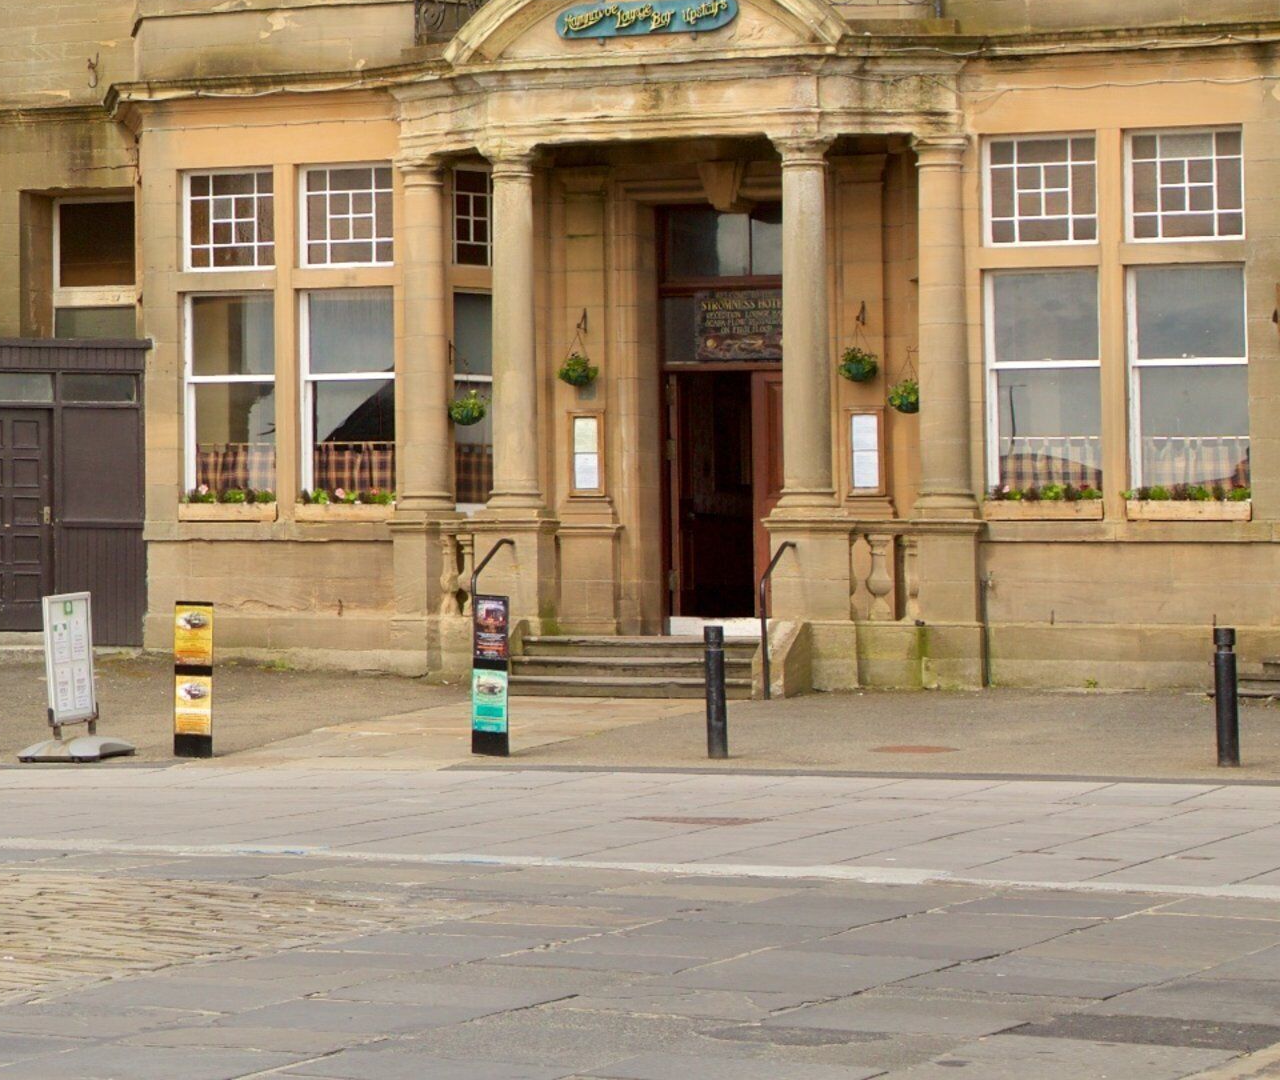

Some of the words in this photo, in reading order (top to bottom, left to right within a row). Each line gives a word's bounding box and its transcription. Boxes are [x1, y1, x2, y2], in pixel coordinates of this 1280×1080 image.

[649, 9, 676, 32] Bar
[701, 299, 755, 311] STROMNESS
[757, 298, 782, 310] HOTE
